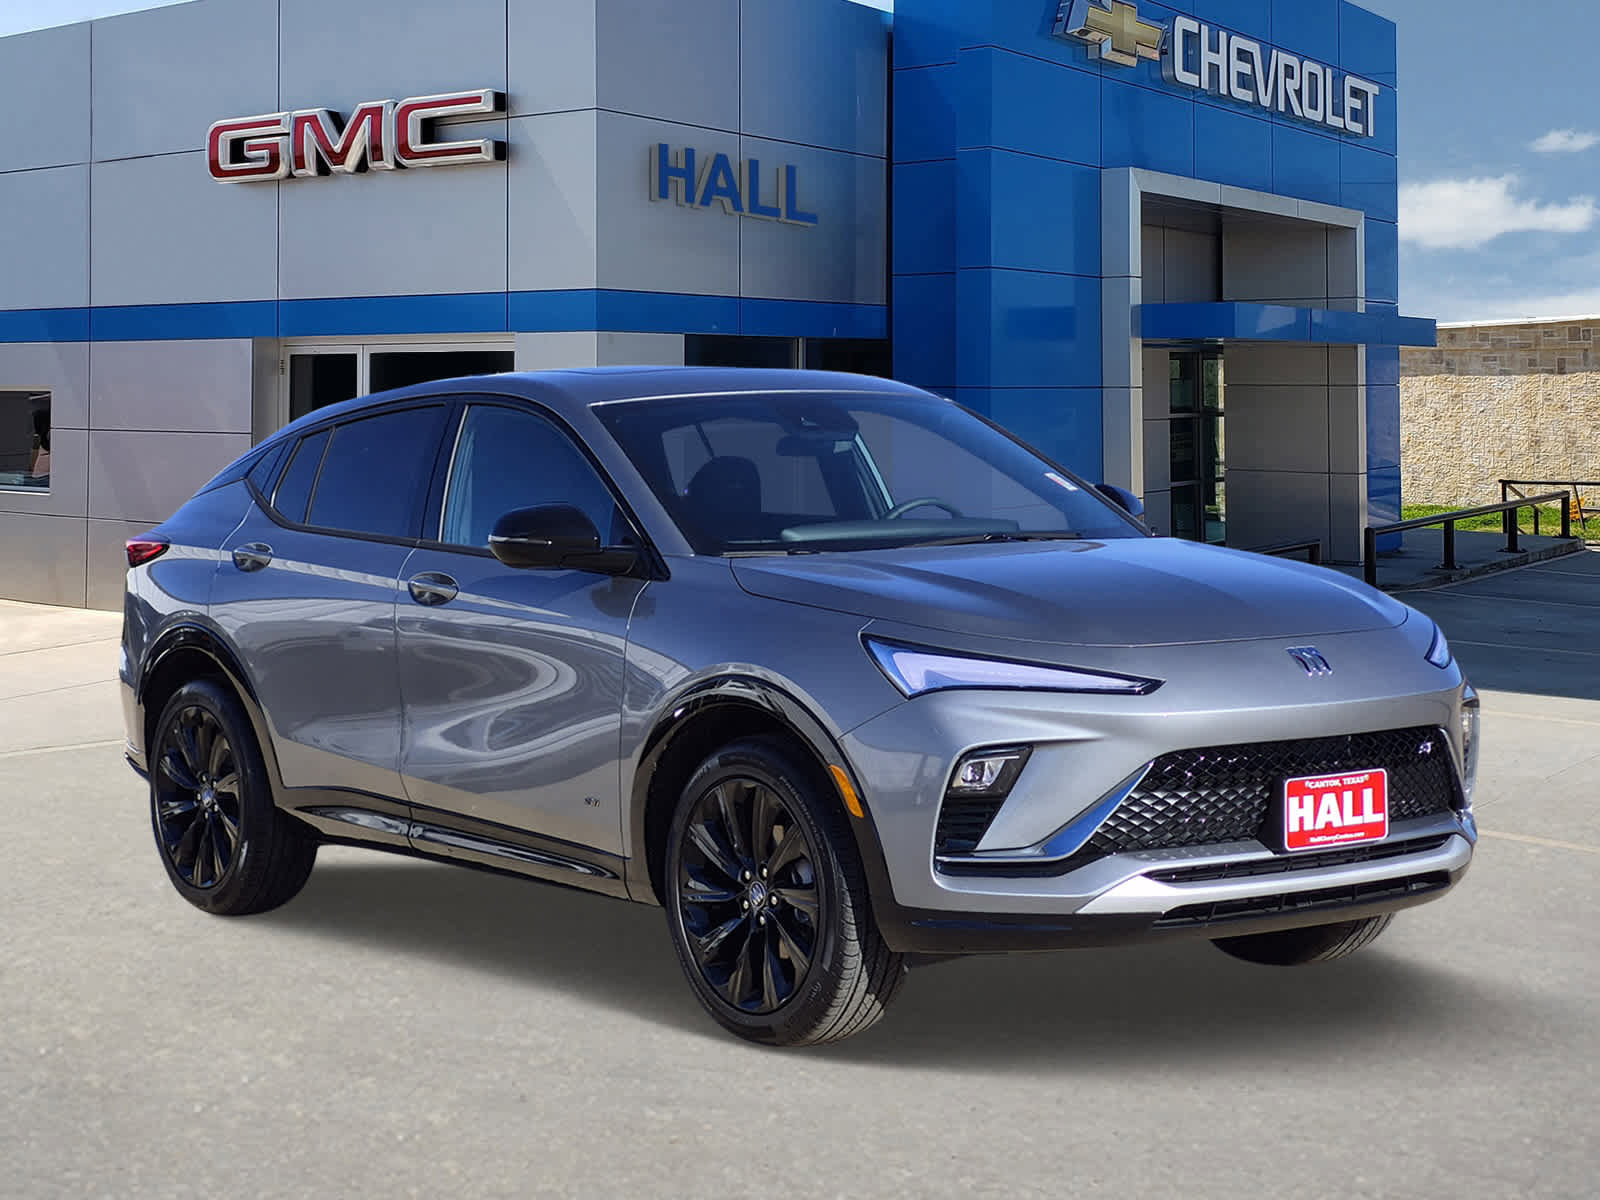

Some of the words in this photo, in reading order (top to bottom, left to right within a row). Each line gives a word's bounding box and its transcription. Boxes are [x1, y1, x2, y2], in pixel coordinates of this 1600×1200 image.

[1174, 15, 1379, 137] CHEVROLET
[207, 88, 507, 184] GMC
[655, 143, 819, 225] HALL
[1288, 787, 1384, 832] HALL
